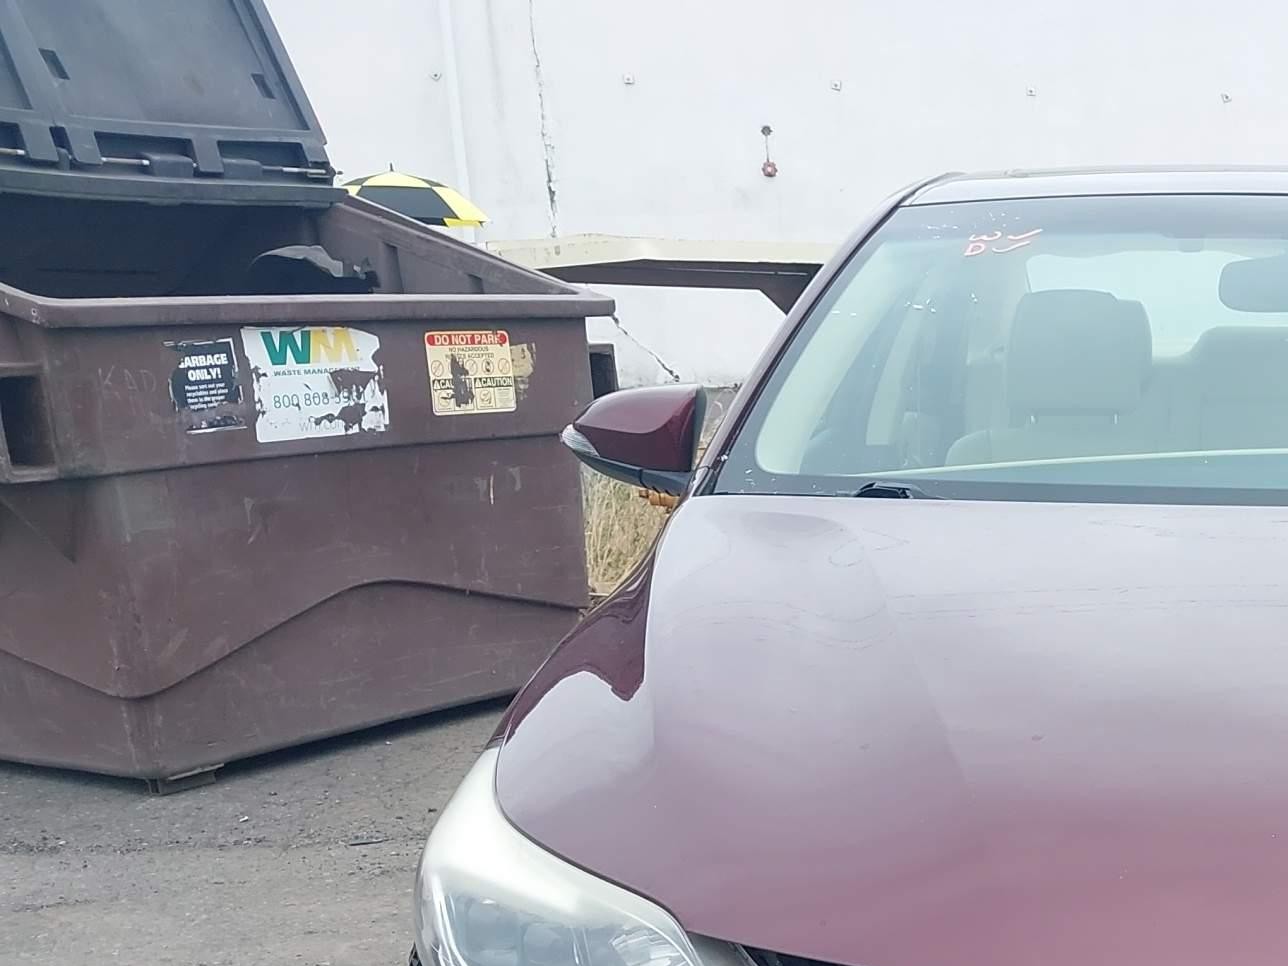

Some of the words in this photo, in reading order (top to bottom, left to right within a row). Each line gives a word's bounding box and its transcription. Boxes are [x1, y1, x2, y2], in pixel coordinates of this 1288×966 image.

[434, 335, 450, 345] DO
[451, 335, 473, 345] NOT
[260, 329, 357, 366] WM
[187, 368, 222, 381] ONLY!
[481, 376, 513, 388] CAUTION
[273, 394, 300, 409] 800
